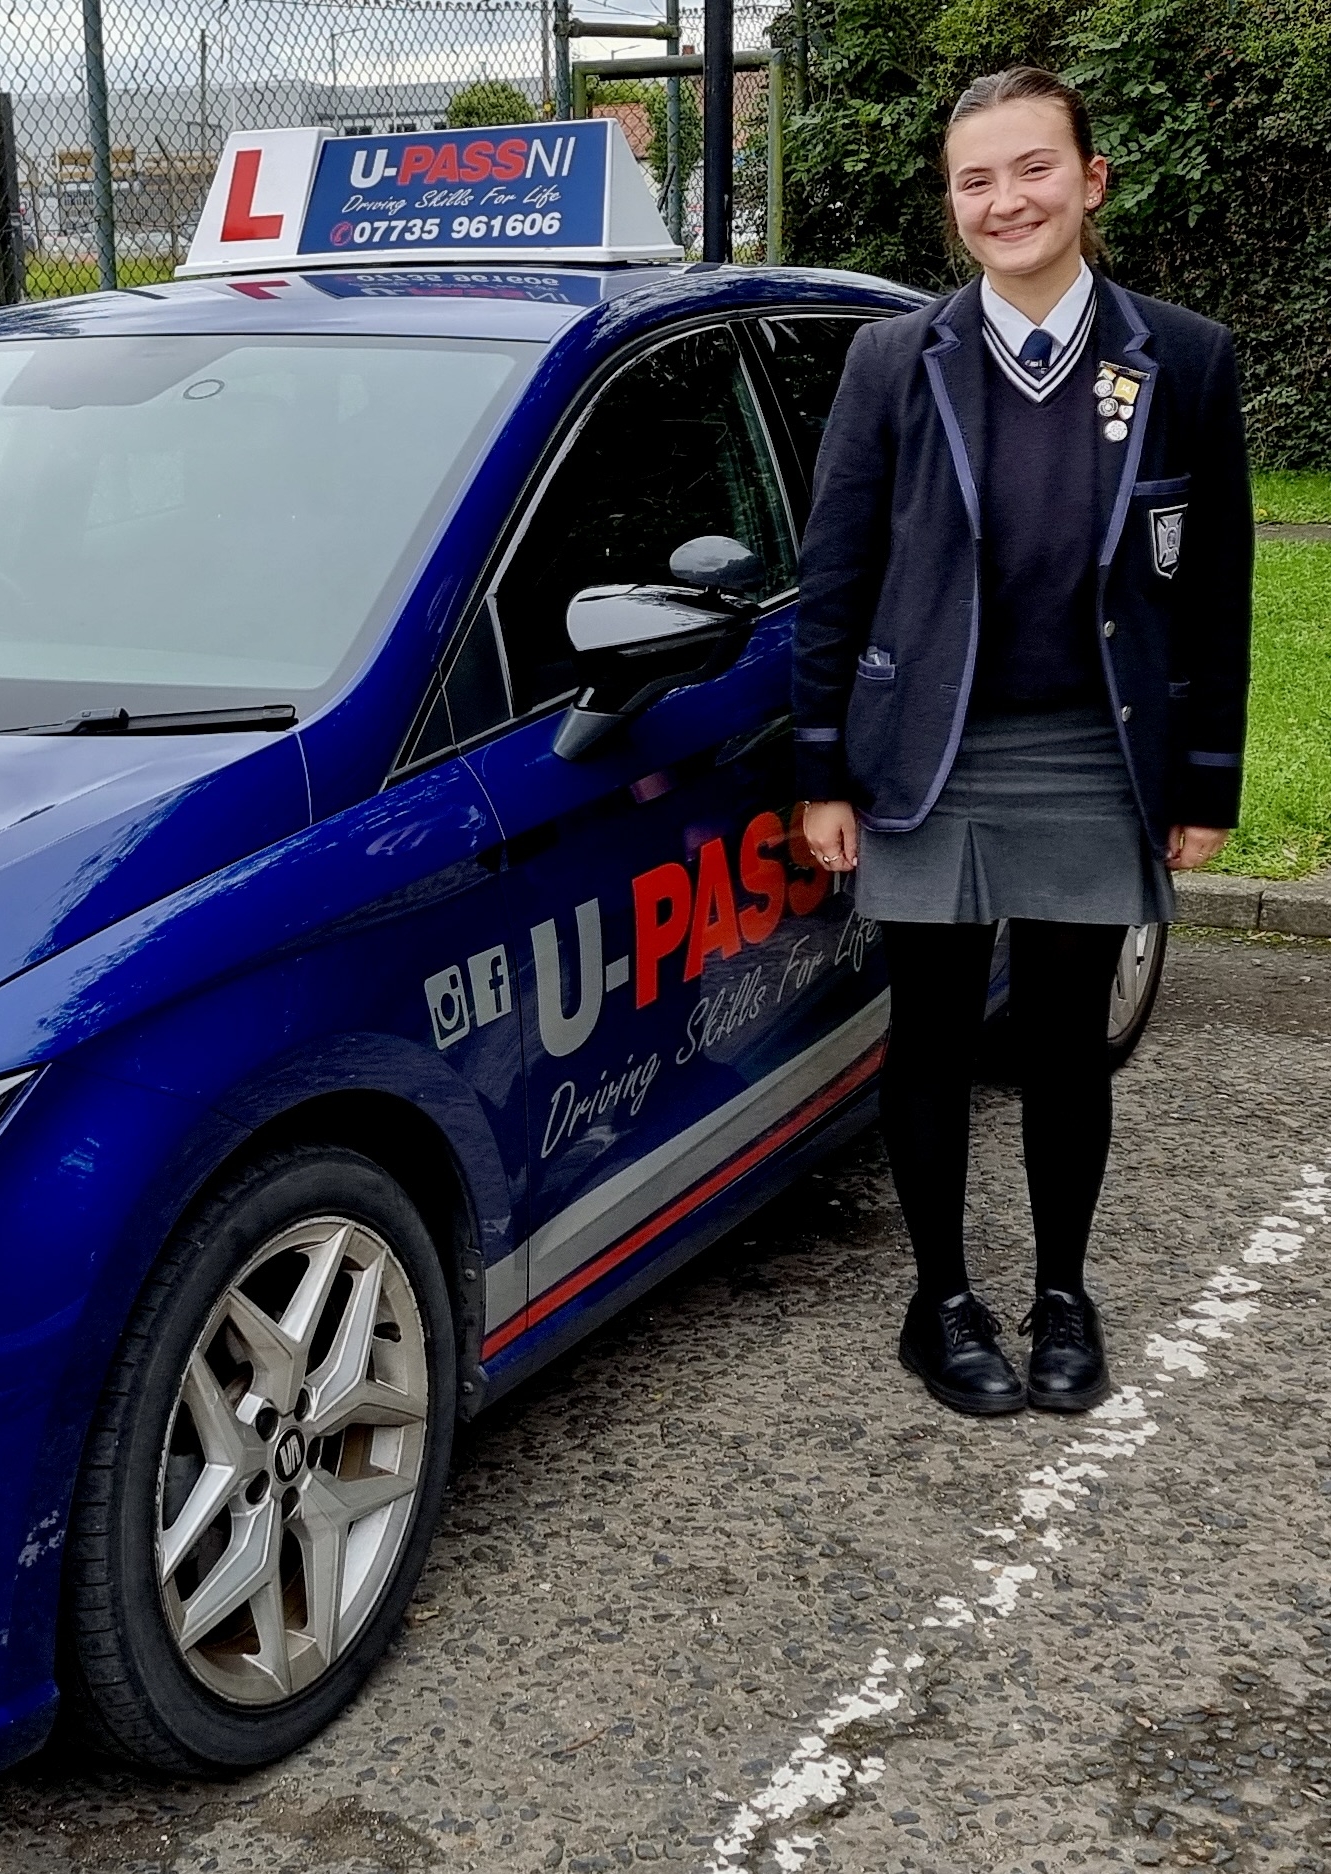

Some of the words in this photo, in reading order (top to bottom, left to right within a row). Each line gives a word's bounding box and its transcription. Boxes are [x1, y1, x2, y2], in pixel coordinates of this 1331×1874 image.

[219, 148, 285, 243] L
[341, 195, 407, 215] Driving
[415, 188, 474, 208] Skills
[480, 186, 517, 205] For
[523, 184, 562, 209] Life
[353, 218, 441, 244] 07735
[451, 211, 562, 239] 961606
[541, 1053, 661, 1158] Driving
[676, 965, 767, 1064] Skills
[777, 934, 825, 1003] For
[835, 907, 879, 972] Life
